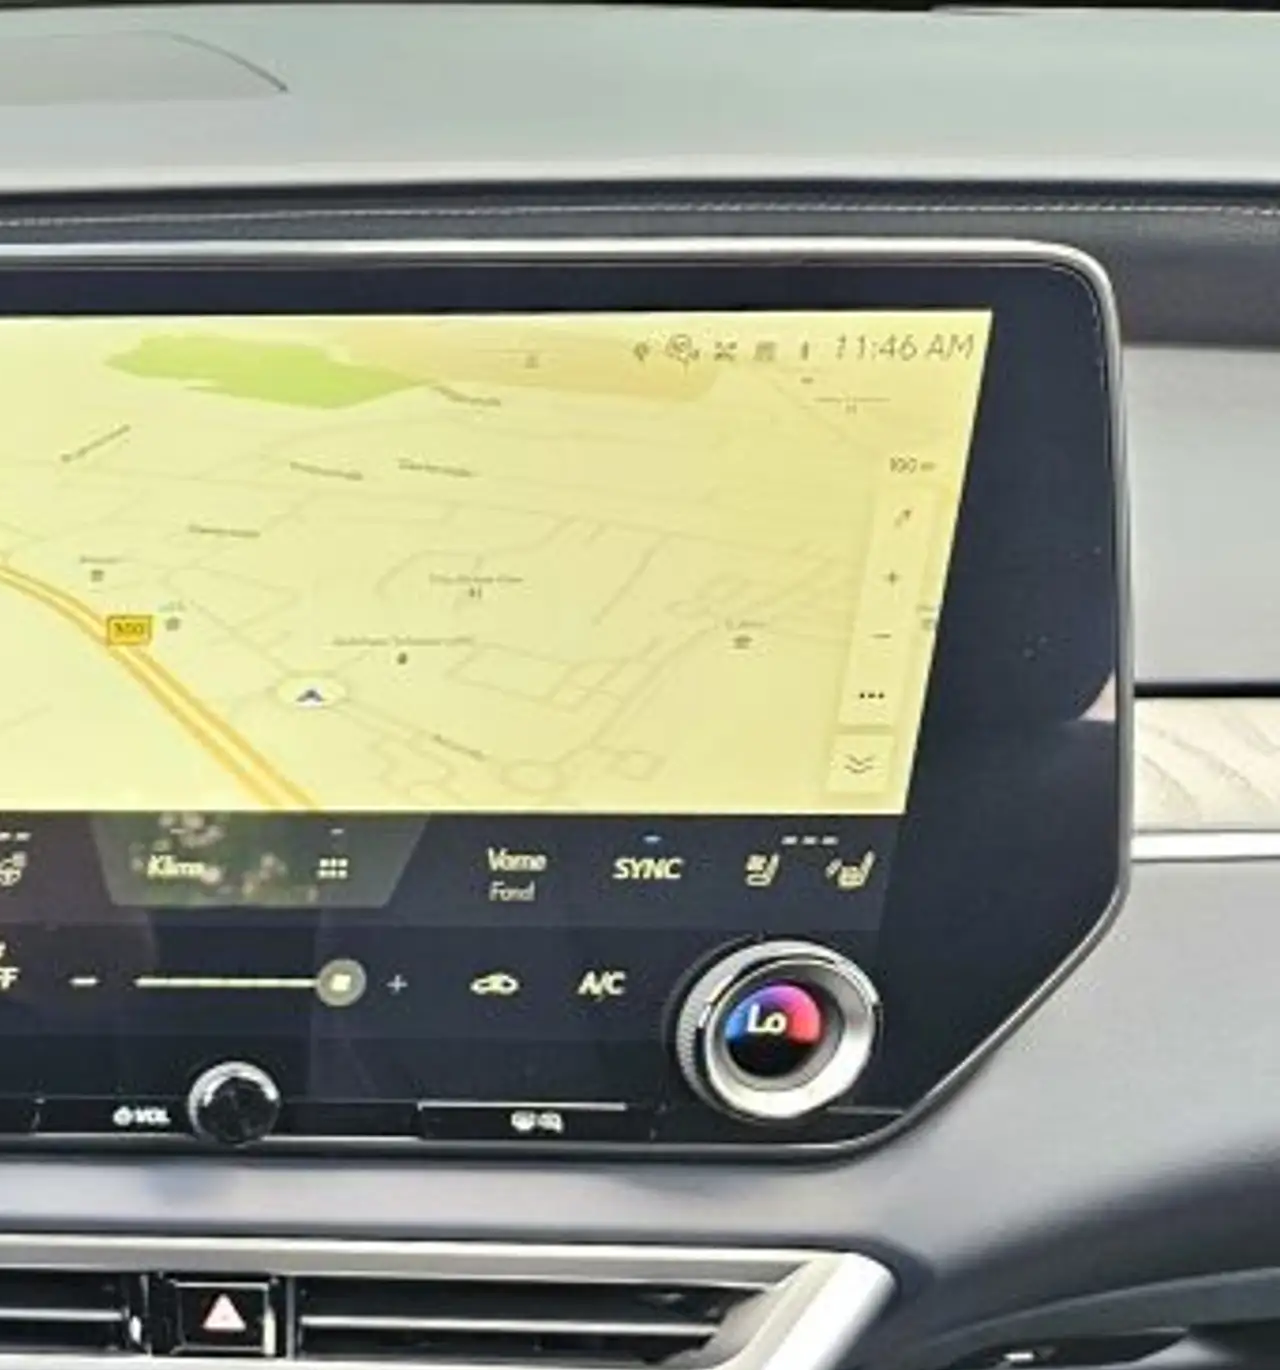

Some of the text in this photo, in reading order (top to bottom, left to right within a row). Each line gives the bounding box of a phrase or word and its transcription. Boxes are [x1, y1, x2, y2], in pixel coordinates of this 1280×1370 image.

[836, 333, 974, 361] 11:46 AM
[612, 856, 684, 880] SYNC
[490, 879, 536, 901] Fond
[577, 970, 628, 999] A/C
[746, 1003, 787, 1035] Lo
[134, 1107, 172, 1125] VOL
